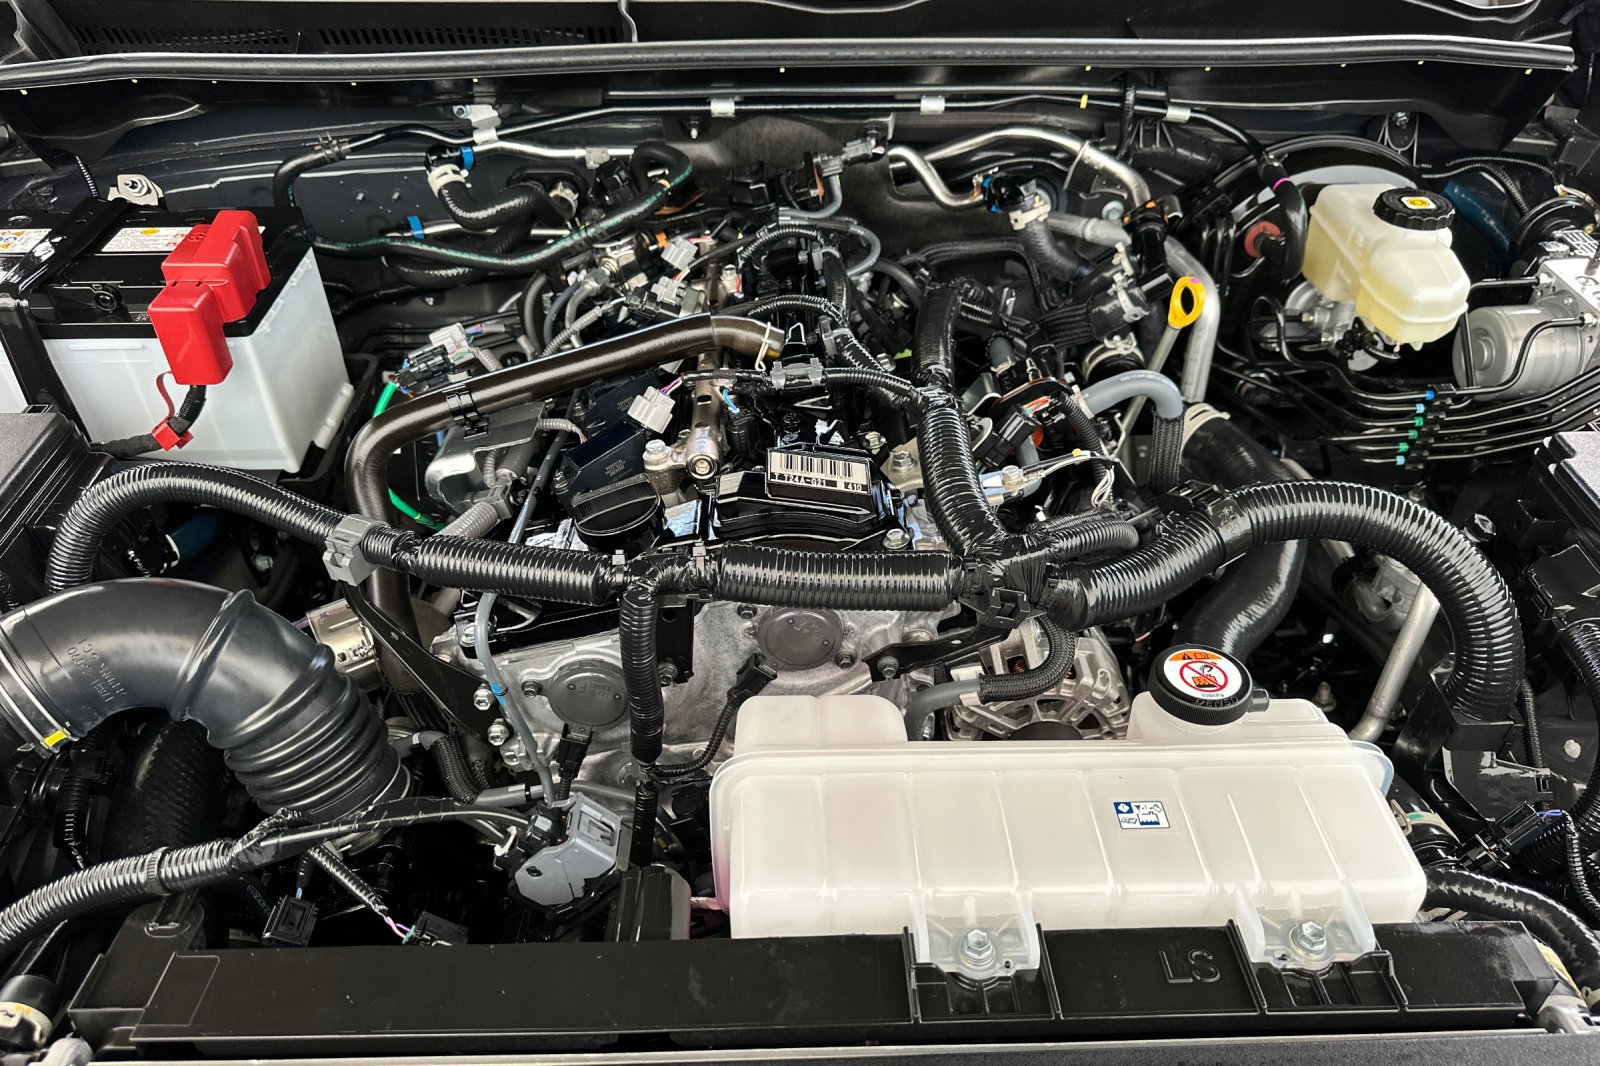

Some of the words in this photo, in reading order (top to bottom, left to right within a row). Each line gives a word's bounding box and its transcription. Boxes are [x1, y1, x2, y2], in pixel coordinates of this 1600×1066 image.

[774, 472, 779, 480] T
[847, 483, 862, 491] 410
[1195, 696, 1239, 708] DENSO
[1157, 948, 1221, 984] LS
